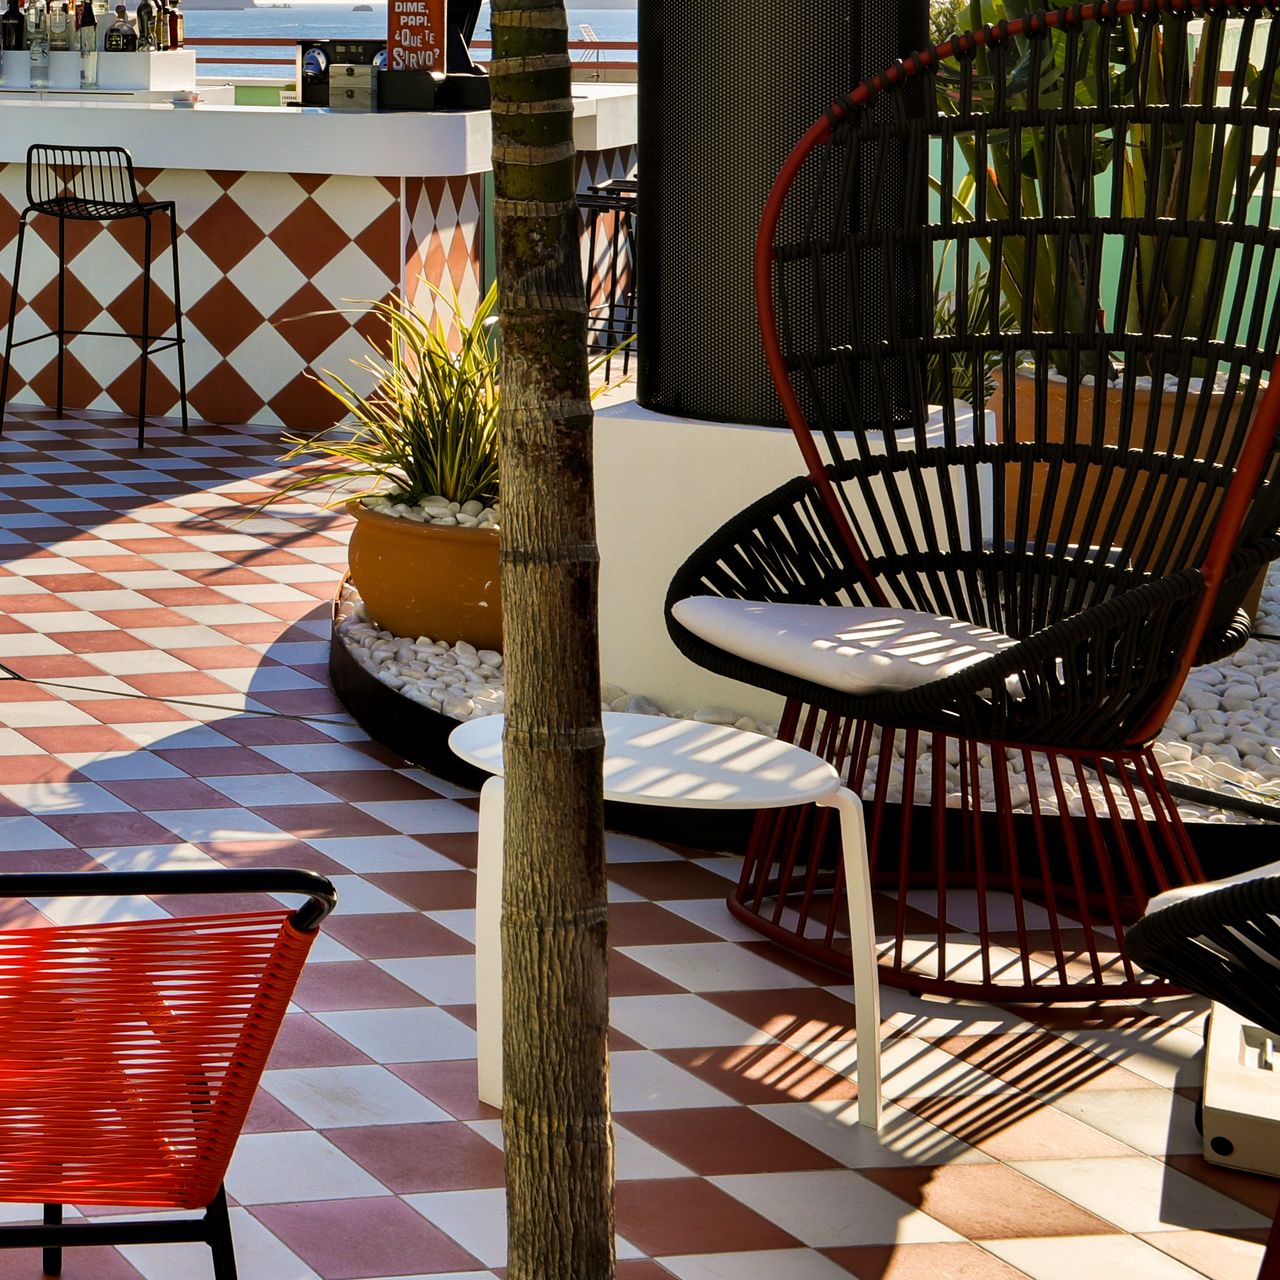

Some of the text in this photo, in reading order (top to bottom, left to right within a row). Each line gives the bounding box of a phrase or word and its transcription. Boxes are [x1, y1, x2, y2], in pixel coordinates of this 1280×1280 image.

[394, 2, 429, 14] DIME,
[400, 15, 431, 27] PAPI.
[424, 30, 436, 44] TE
